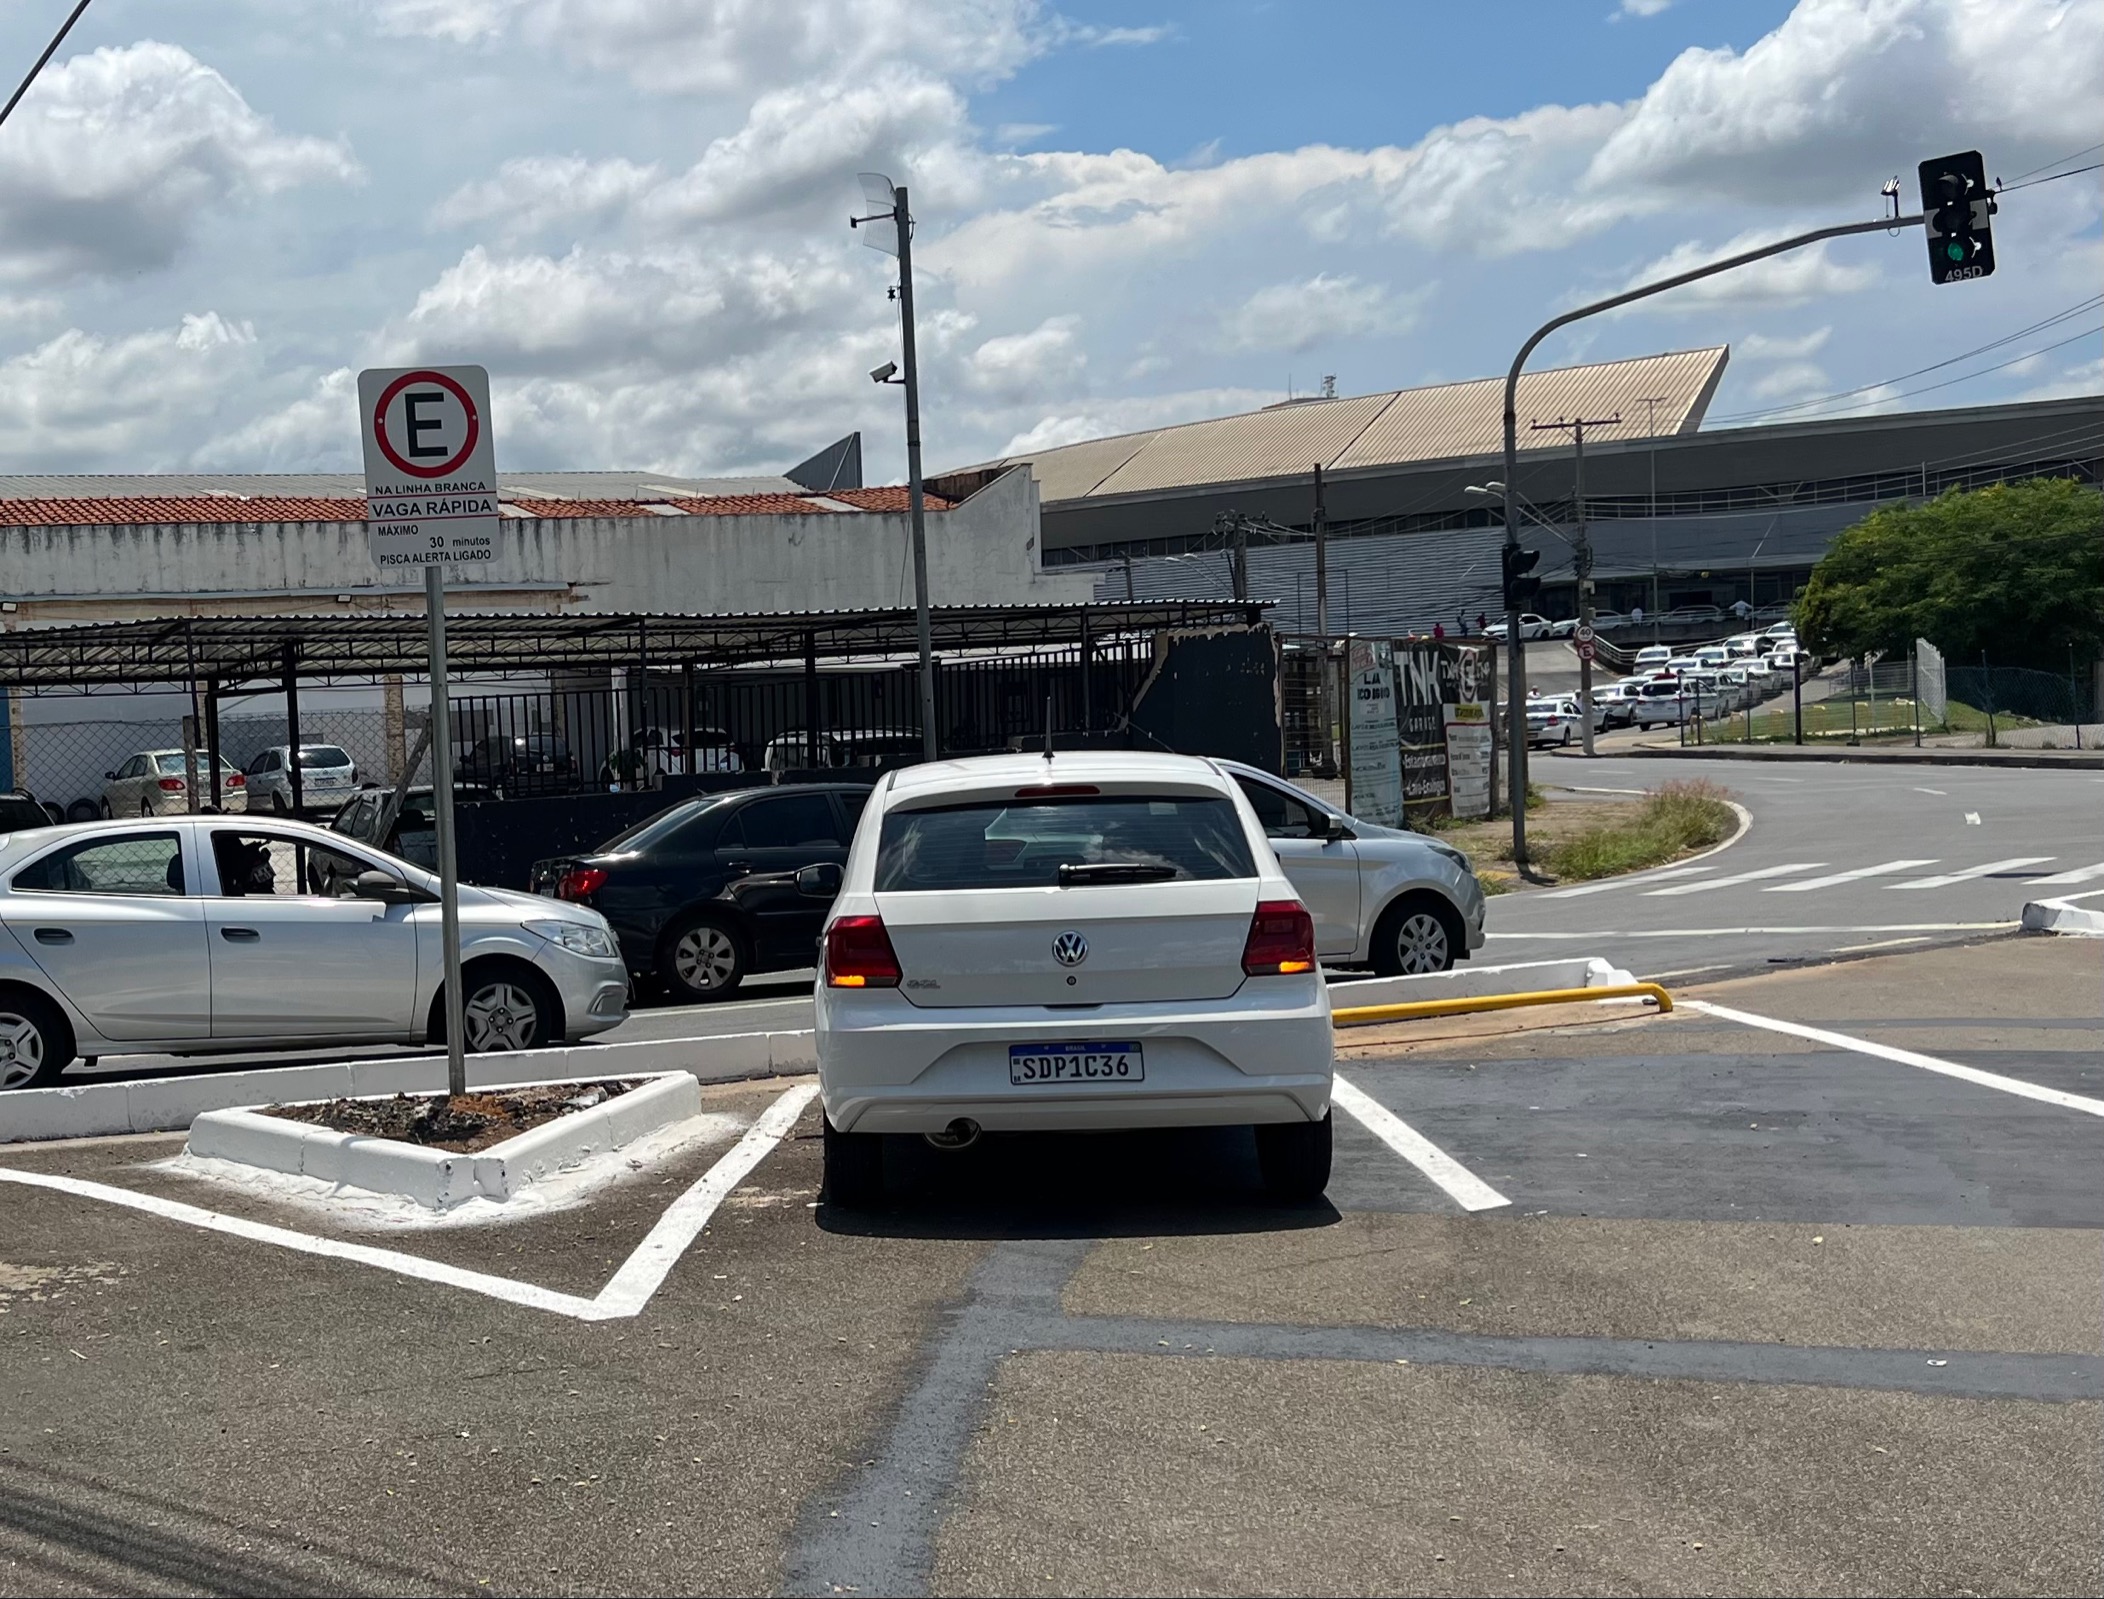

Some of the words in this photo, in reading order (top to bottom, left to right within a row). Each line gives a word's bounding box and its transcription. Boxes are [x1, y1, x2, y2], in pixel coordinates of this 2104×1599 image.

[1945, 265, 1983, 282] 495D
[405, 392, 448, 457] E
[375, 486, 392, 495] NA
[396, 484, 432, 494] LINHA
[435, 481, 486, 493] BRANCA
[372, 502, 422, 517] VAGA
[426, 498, 493, 514] RÁPIDA
[378, 523, 419, 537] MÁXIMO
[429, 536, 444, 548] 30
[452, 536, 491, 547] minutos
[380, 553, 410, 565] PISCA
[412, 551, 451, 563] ALERTA
[453, 549, 491, 561] LIGADO
[1579, 628, 1591, 636] 40
[1582, 646, 1591, 657] E
[1393, 651, 1442, 707] TNK
[1022, 1054, 1129, 1080] SDP1C36
